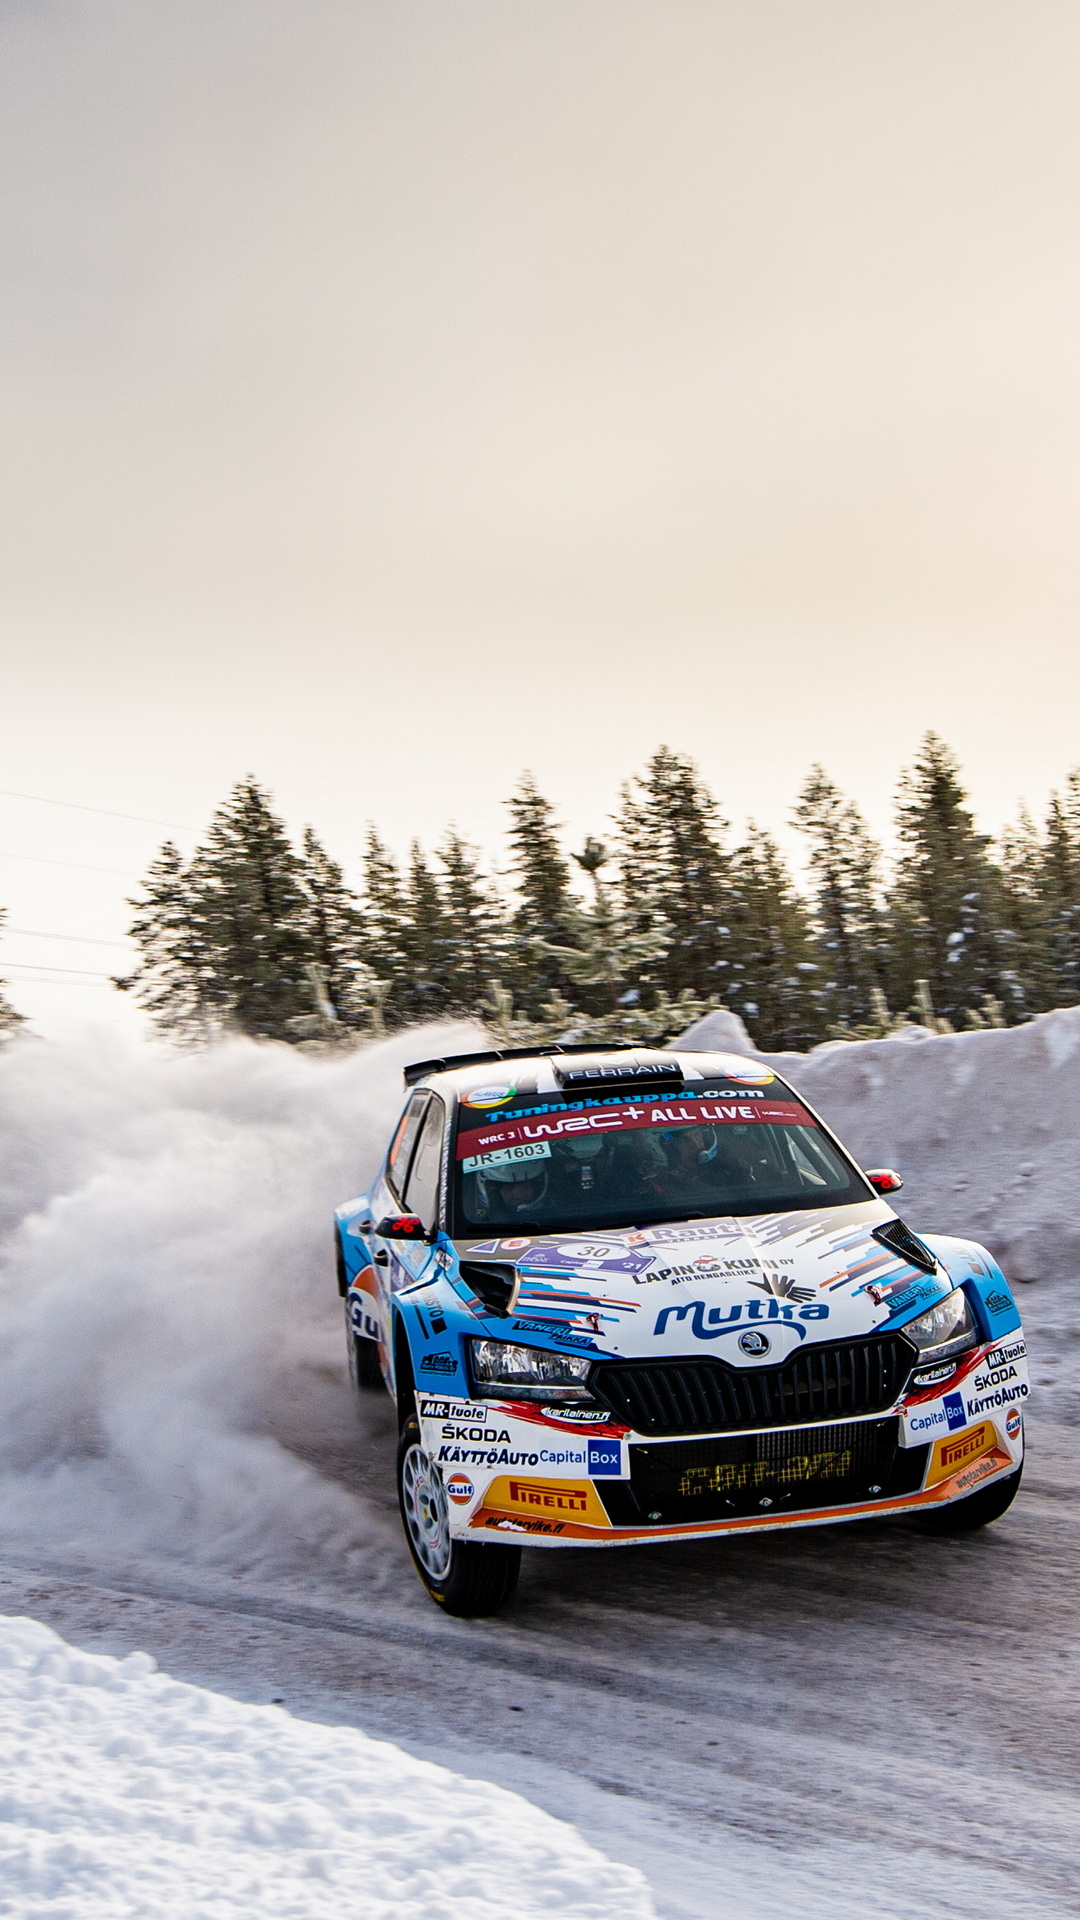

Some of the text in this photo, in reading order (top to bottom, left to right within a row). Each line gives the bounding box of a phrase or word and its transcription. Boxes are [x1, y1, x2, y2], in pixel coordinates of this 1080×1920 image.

[569, 1064, 676, 1080] FERRAIN
[485, 1089, 764, 1122] Tuningkauppa.com
[651, 1107, 696, 1122] ALL
[700, 1106, 755, 1120] LIVE
[478, 1131, 516, 1146] WRC 3
[469, 1144, 546, 1168] JR-1603
[628, 1231, 648, 1243] K
[577, 1246, 610, 1258] 30
[632, 1264, 694, 1285] LAPIN
[725, 1258, 778, 1271] KUMI
[671, 1270, 757, 1285] AITO RENGASLIIKE
[653, 1299, 829, 1340] Mutka
[974, 1366, 1017, 1391] ŠKODA
[1006, 1416, 1020, 1430] Gulf
[441, 1424, 511, 1443] ŠKODA
[941, 1427, 985, 1467] PIRELLI
[448, 1484, 473, 1494] Gulf
[509, 1480, 588, 1511] PIRELLI
